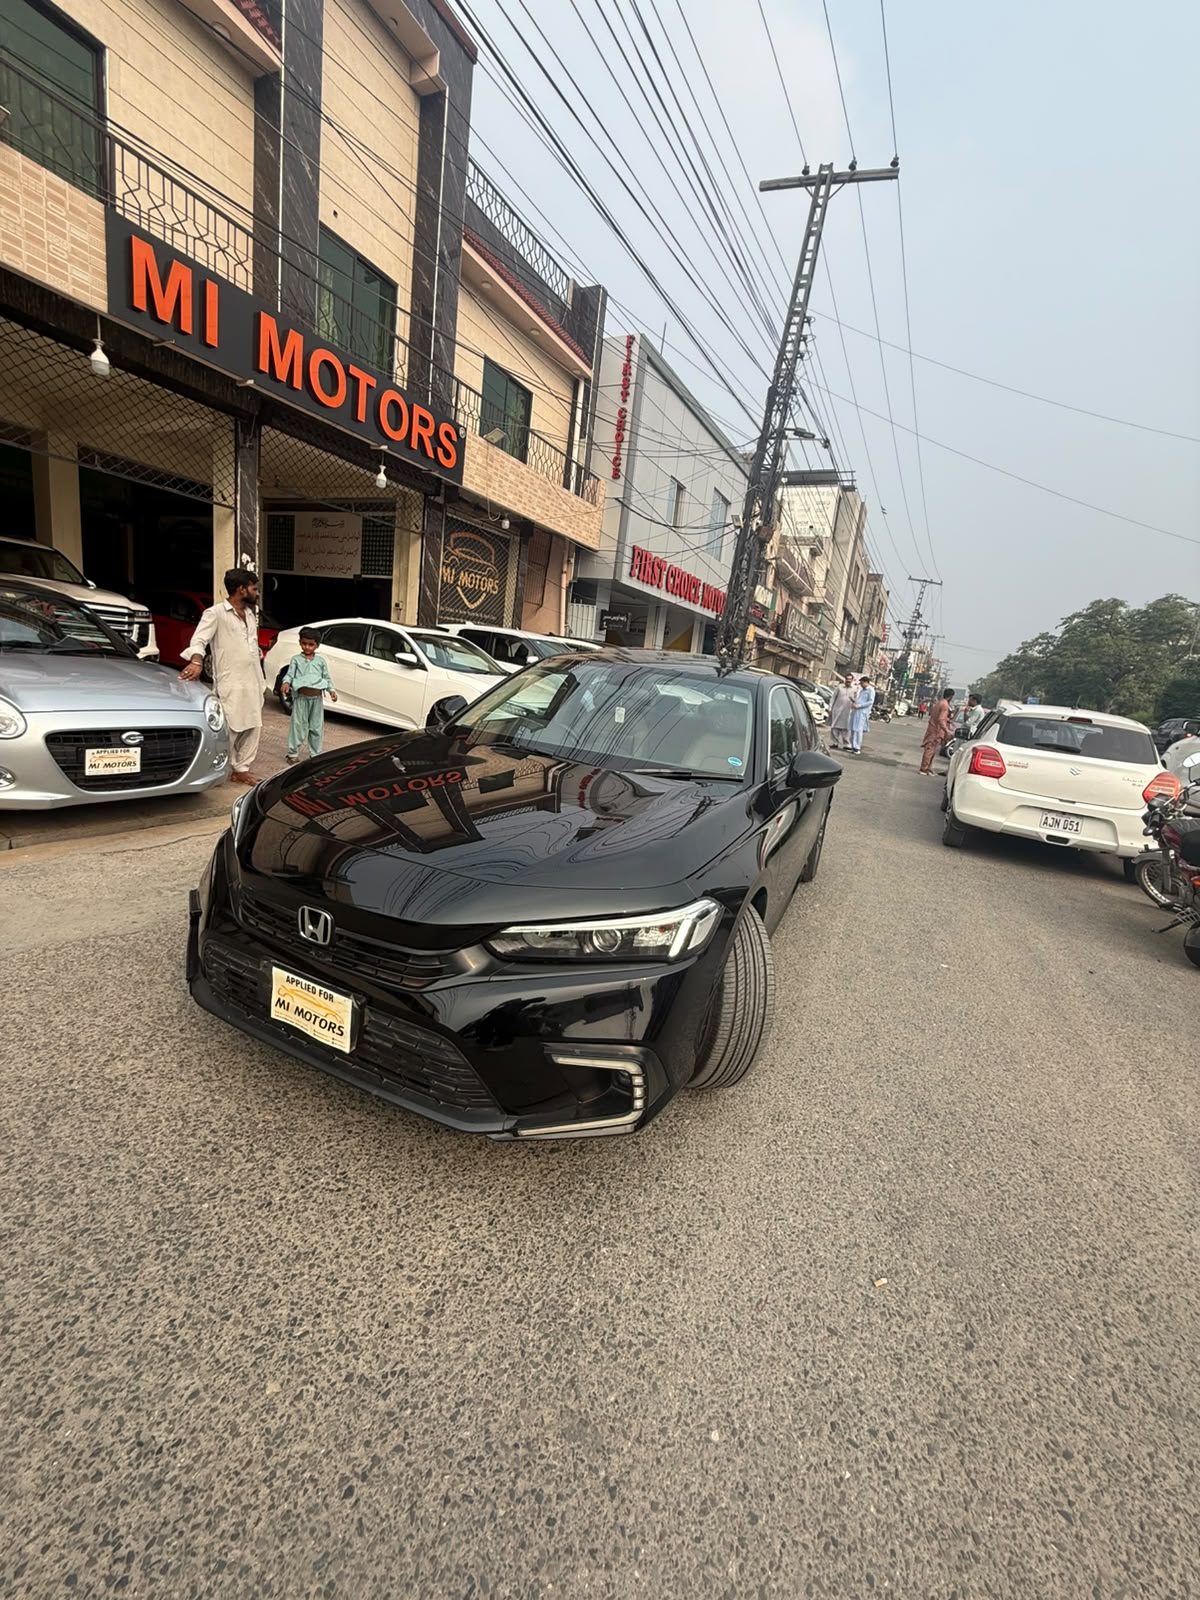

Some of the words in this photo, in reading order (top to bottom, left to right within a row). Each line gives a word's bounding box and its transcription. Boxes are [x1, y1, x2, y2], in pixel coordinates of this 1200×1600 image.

[131, 235, 219, 348] MI
[258, 311, 458, 469] MOTORS
[620, 334, 635, 403] FIRST
[611, 407, 627, 480] CHOICE
[441, 566, 455, 584] MI
[457, 571, 499, 595] MOTORS
[630, 545, 667, 589] FIRST
[665, 564, 702, 605] CHOICE
[102, 760, 137, 769] MOTORS
[1042, 816, 1061, 829] AJN
[286, 975, 317, 995] APPLIED
[318, 988, 334, 1003] FOR
[275, 997, 290, 1011] MI
[294, 1006, 345, 1037] MOTORS
